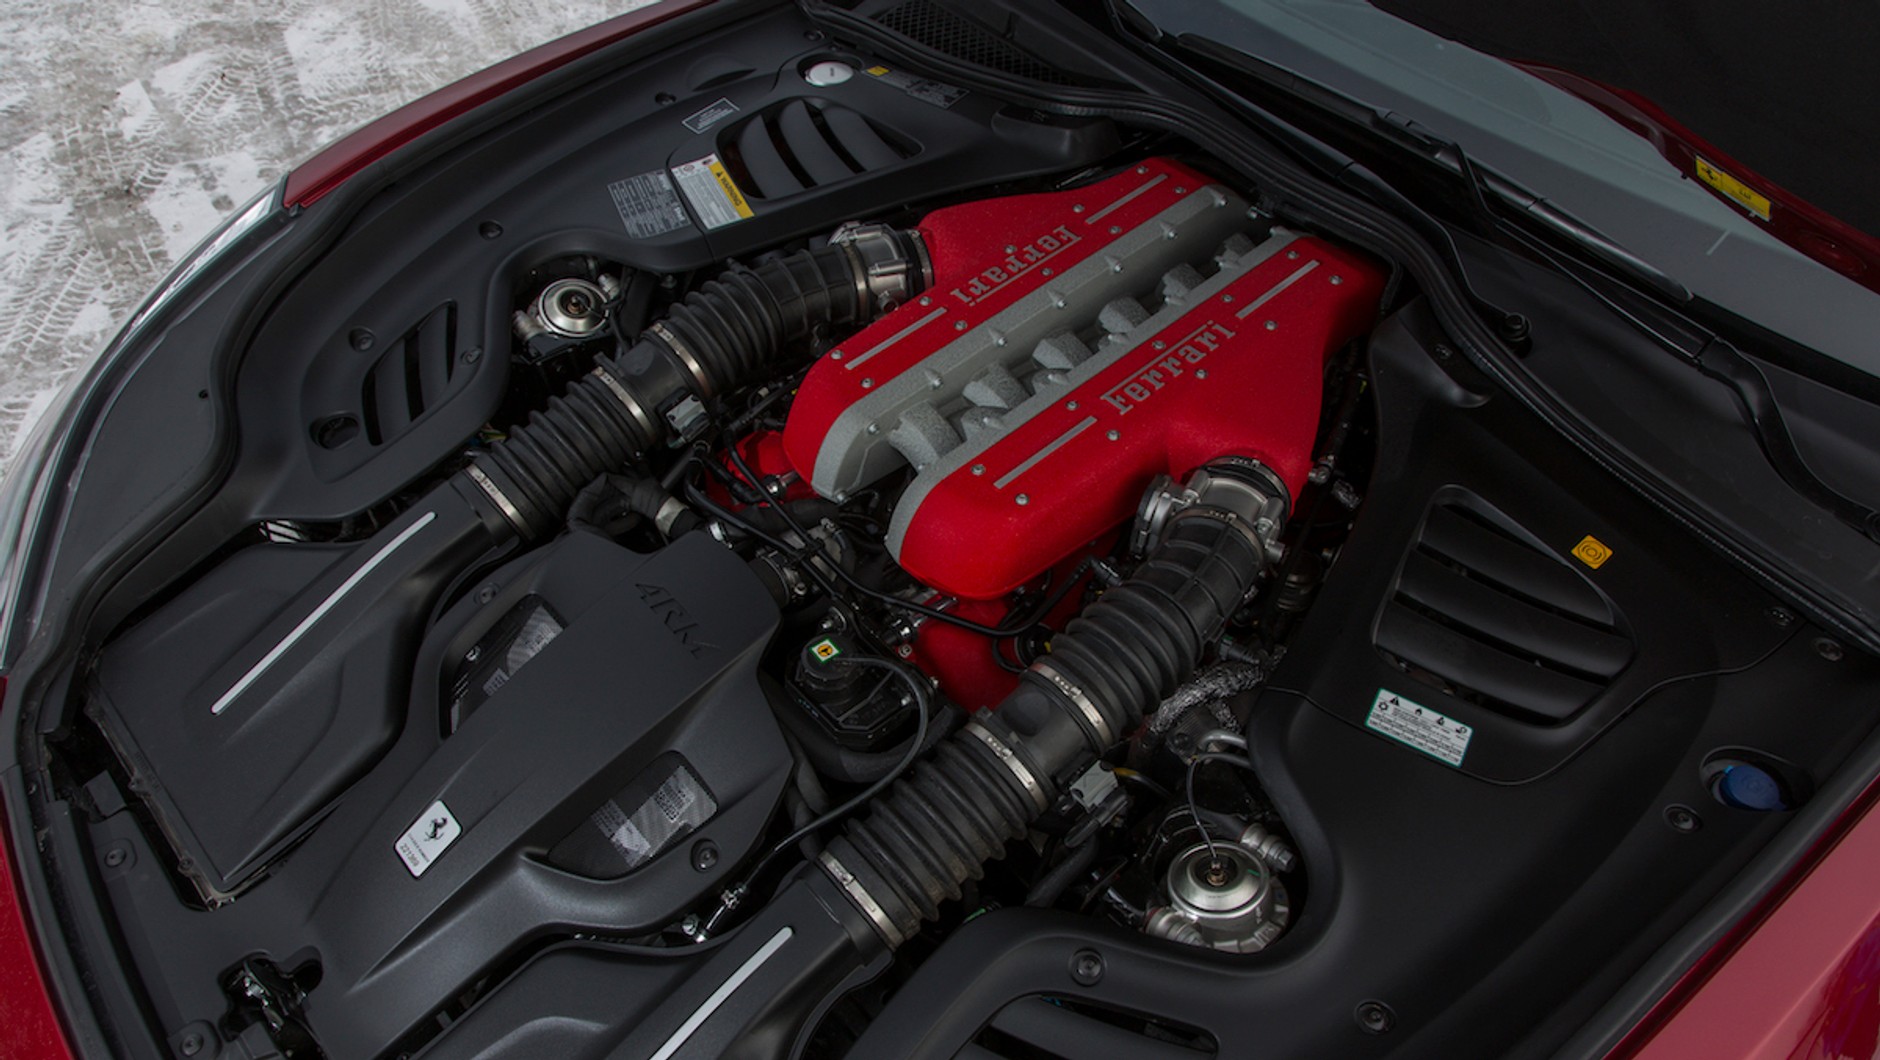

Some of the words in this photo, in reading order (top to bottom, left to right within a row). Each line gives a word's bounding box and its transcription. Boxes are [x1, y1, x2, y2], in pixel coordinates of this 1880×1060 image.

[720, 176, 743, 206] WARNING
[950, 225, 1082, 307] Ferrari
[1101, 320, 1237, 416] Ferrari
